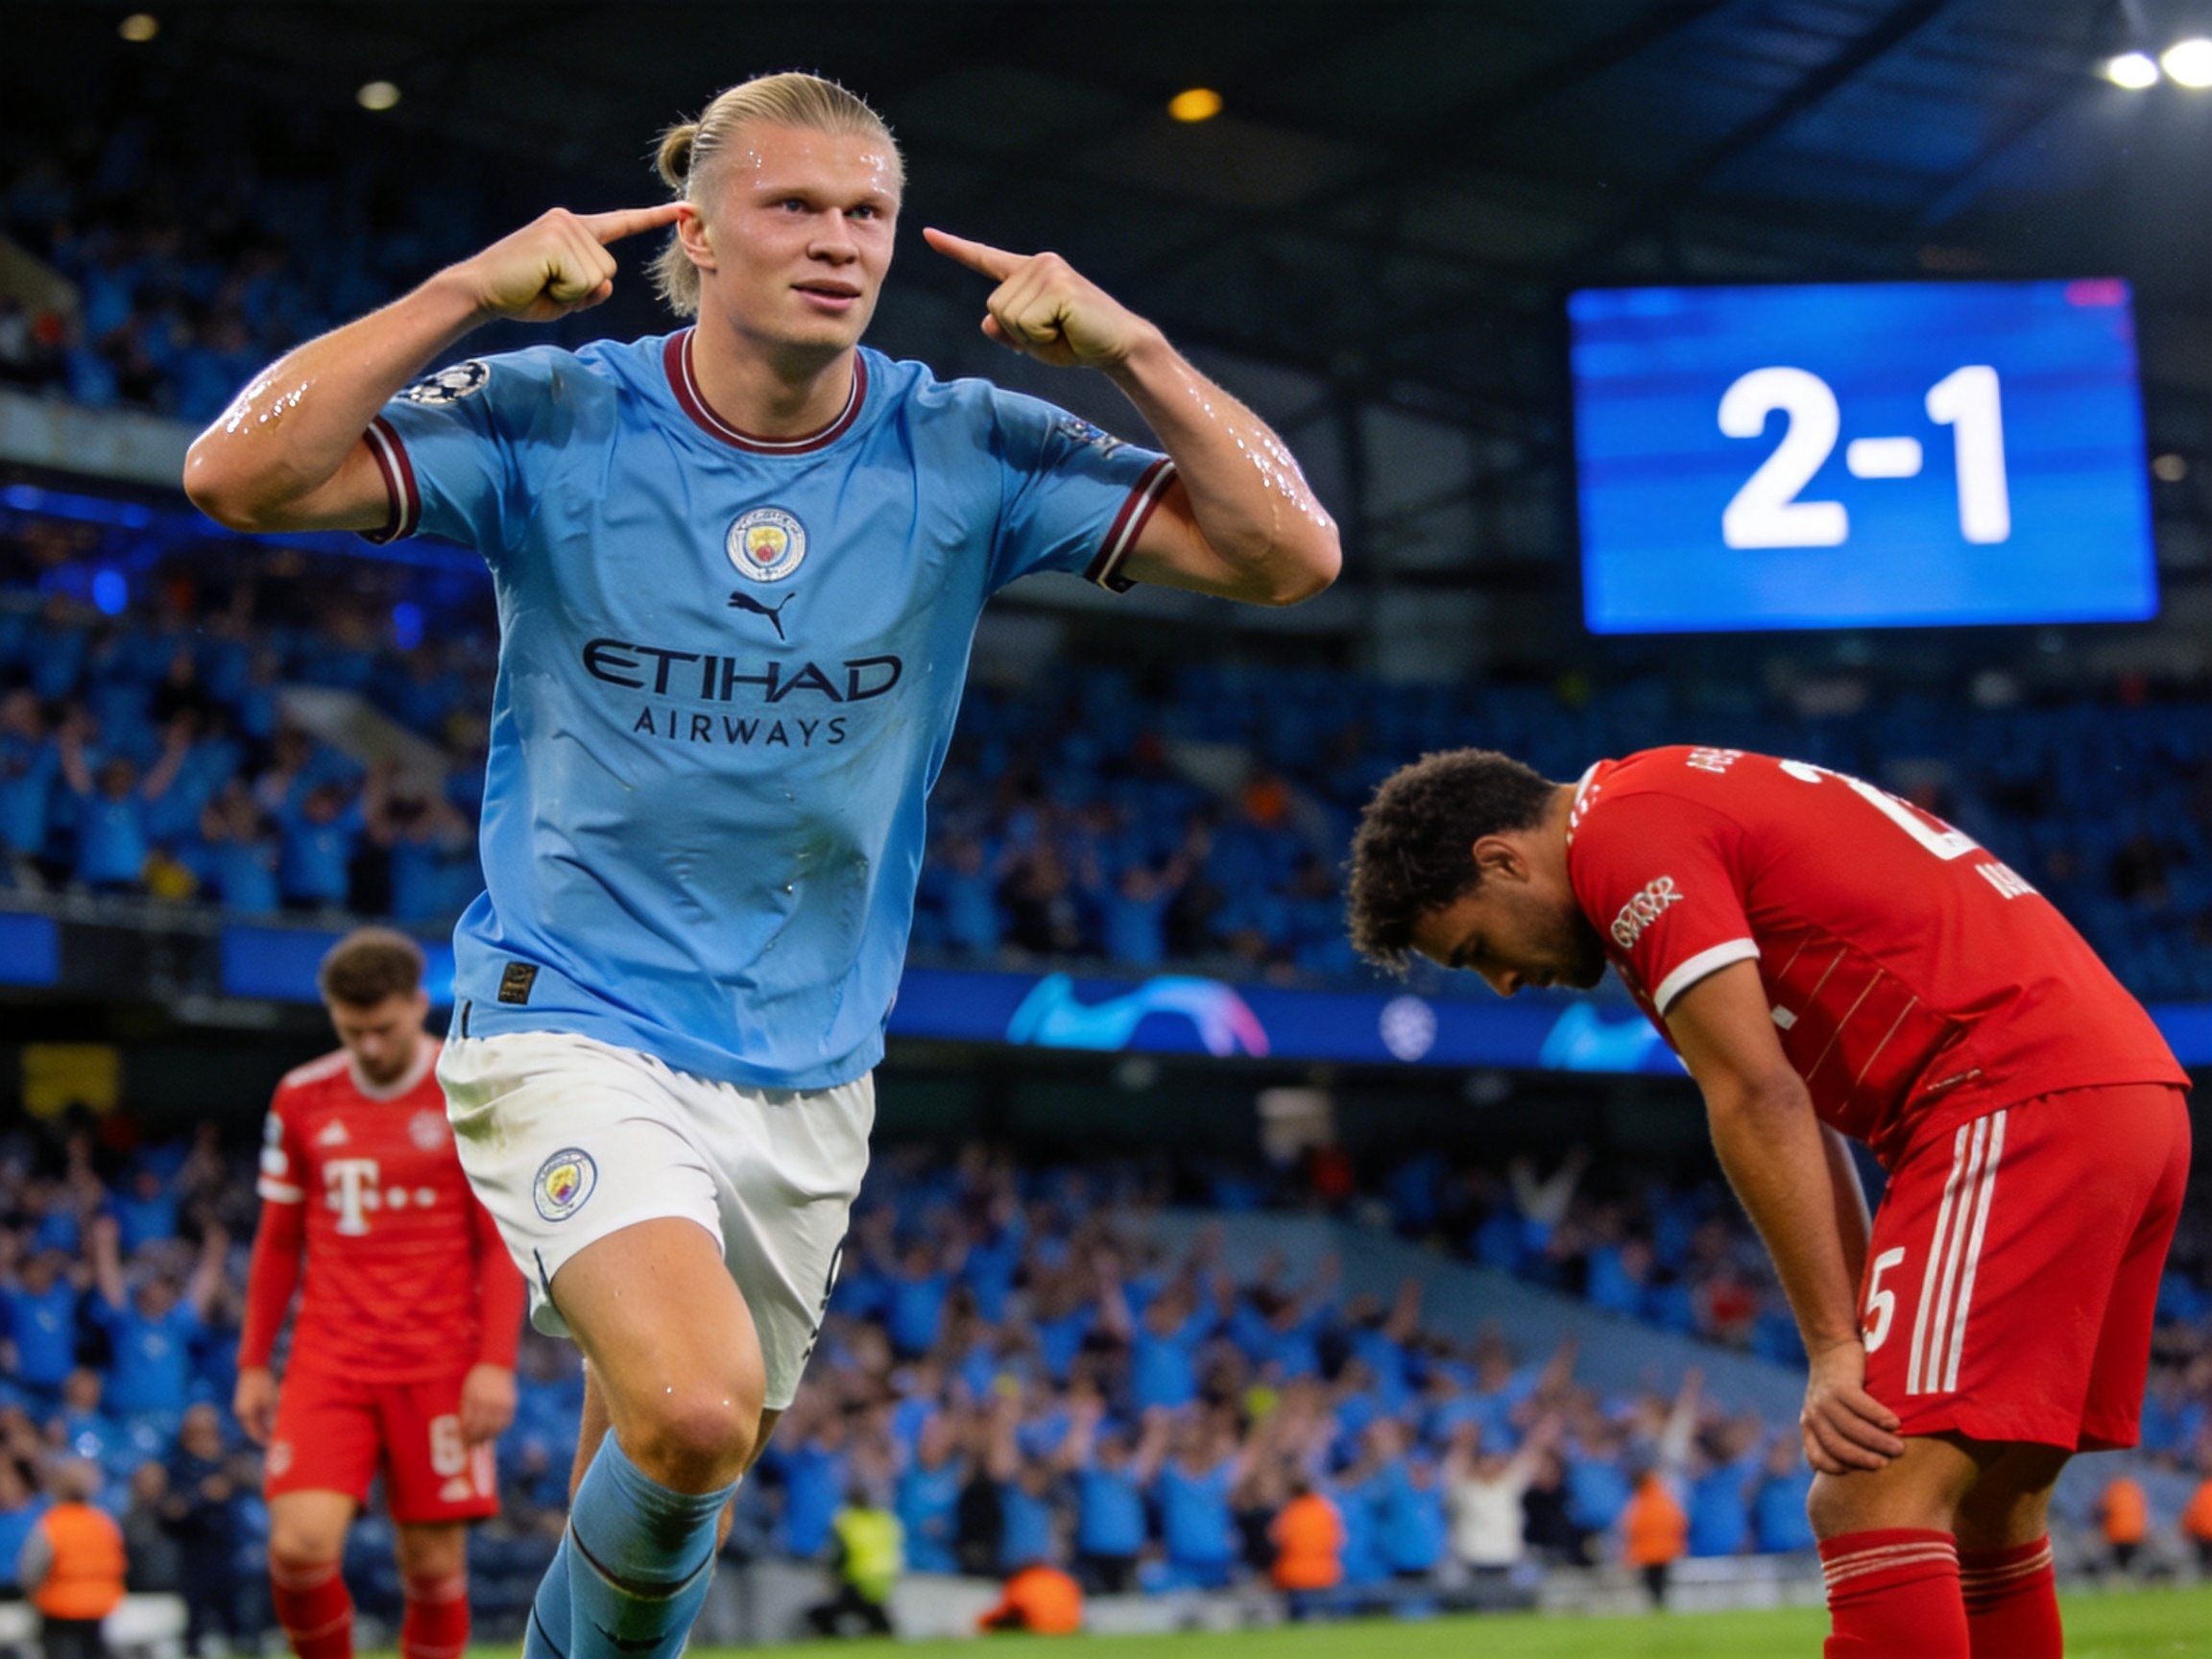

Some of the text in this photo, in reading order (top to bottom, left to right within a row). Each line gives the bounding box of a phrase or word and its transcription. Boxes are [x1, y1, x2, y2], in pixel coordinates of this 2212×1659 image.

[1718, 363, 2010, 549] 2-1
[583, 637, 902, 703] ETIHAD
[634, 706, 847, 748] AIRWAYS
[1863, 1246, 1906, 1354] 5
